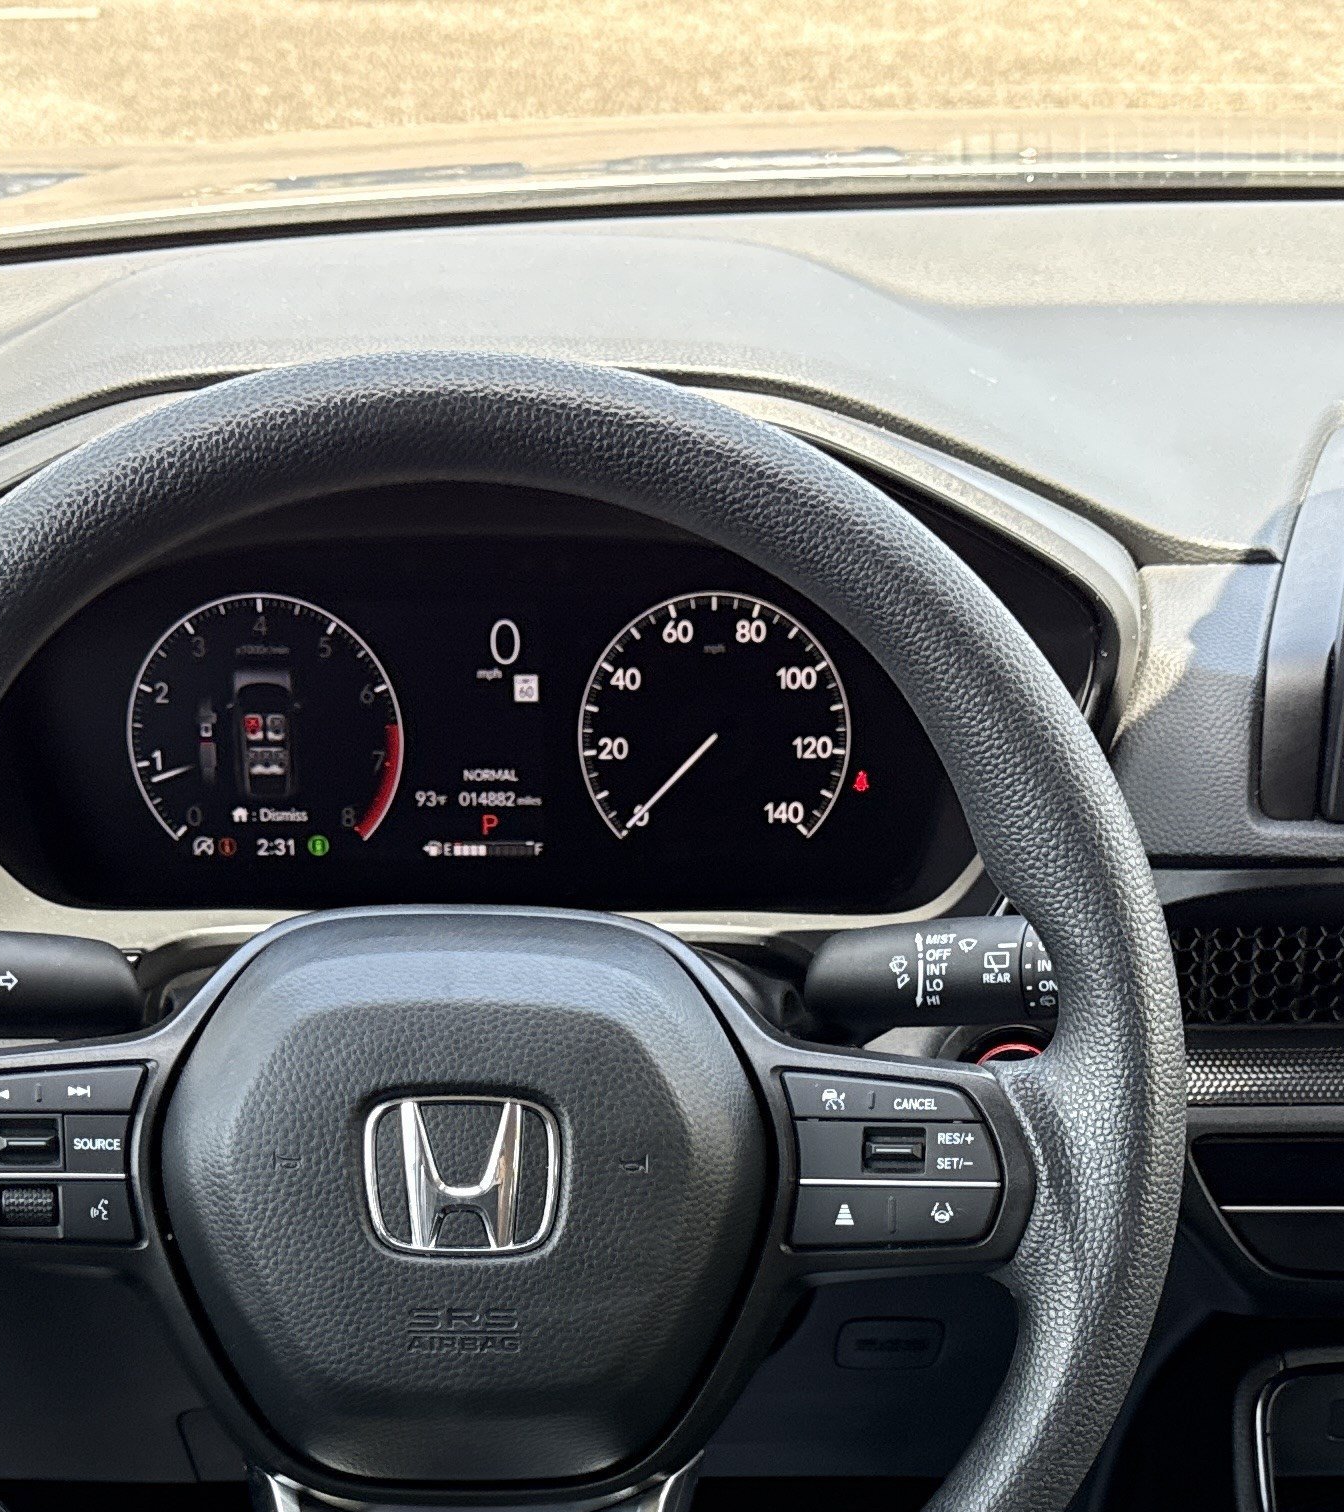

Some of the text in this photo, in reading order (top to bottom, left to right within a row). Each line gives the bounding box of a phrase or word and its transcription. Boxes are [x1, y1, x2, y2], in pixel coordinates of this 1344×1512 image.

[253, 616, 268, 636] 4
[662, 620, 694, 643] 60
[735, 620, 767, 643] 80
[191, 637, 205, 658] 3
[319, 637, 332, 658] 5
[490, 619, 520, 665] 0
[610, 667, 642, 691] 40
[776, 666, 817, 690] 100
[155, 682, 169, 704] 2
[360, 684, 374, 704] 6
[598, 737, 629, 760] 20
[792, 735, 833, 759] 120
[151, 750, 162, 771] 1
[372, 751, 385, 772] 7
[463, 769, 519, 781] NORMAL
[458, 791, 516, 807] 014882
[187, 806, 202, 827] 0
[259, 808, 308, 823] Dismiss
[341, 807, 355, 828] 8
[764, 801, 805, 824] 140
[482, 814, 500, 835] P
[256, 839, 296, 856] 2:31
[444, 842, 453, 857] E
[534, 842, 544, 856] F
[926, 933, 957, 945] MIST
[926, 949, 951, 960] OFF
[927, 963, 947, 975] INT
[982, 972, 1011, 984] REAR
[927, 979, 943, 991] LO
[927, 995, 941, 1006] HI
[893, 1098, 937, 1111] CANCEL
[73, 1138, 121, 1151] SOURCE
[937, 1133, 975, 1145] RES/+
[407, 1308, 519, 1331] SRS
[407, 1336, 521, 1354] AIRBAG
